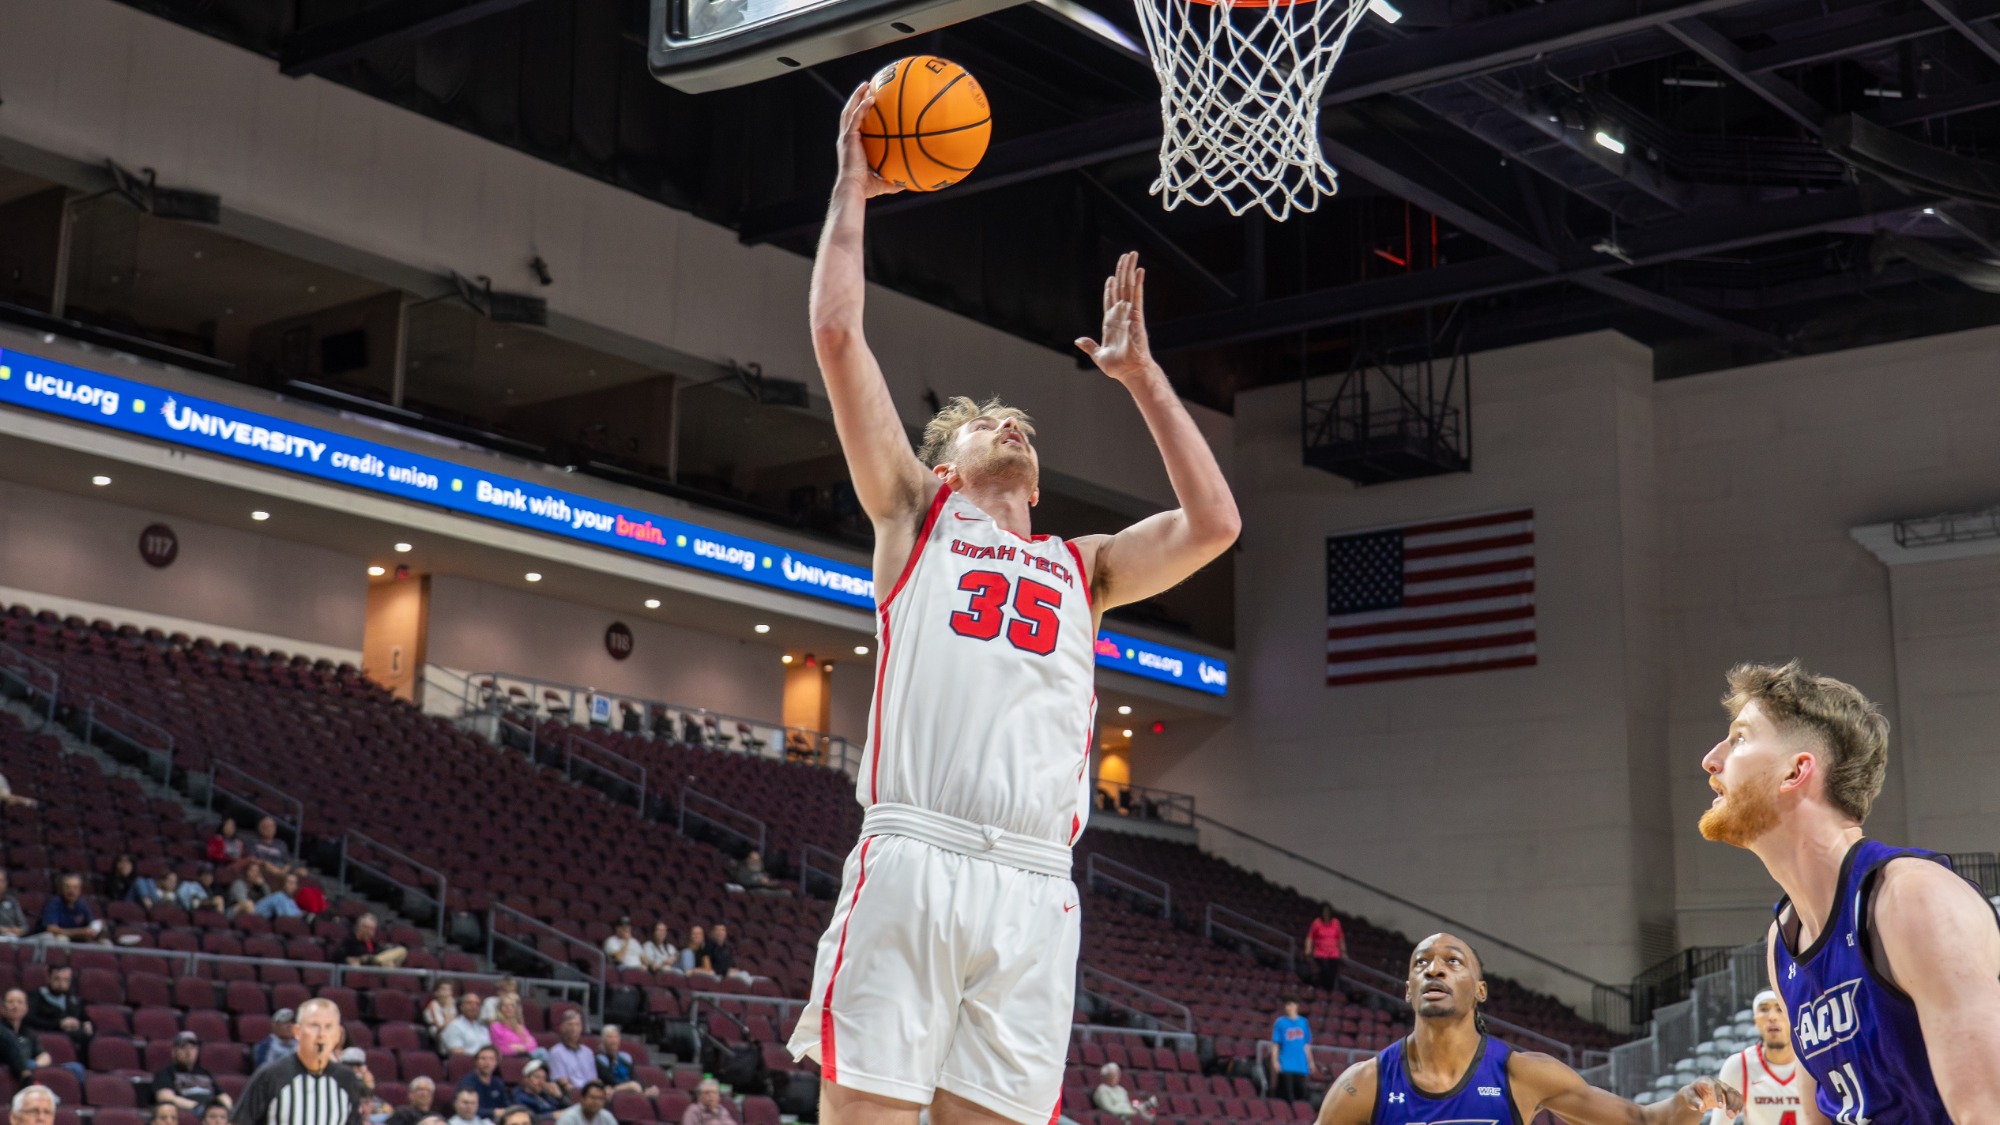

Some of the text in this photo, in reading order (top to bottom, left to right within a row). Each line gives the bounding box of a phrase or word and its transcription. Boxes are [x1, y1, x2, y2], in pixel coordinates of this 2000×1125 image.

[25, 371, 119, 415] ucu.org
[164, 398, 439, 492] UNIVERSITY credit union
[476, 479, 667, 546] Bank with your brain.
[147, 534, 174, 557] 117
[693, 538, 755, 572] ucu.org
[950, 539, 1074, 589] UTAH TECH
[782, 555, 874, 599] UNIVERSIT
[949, 570, 1062, 656] 35
[1800, 991, 1854, 1050] ACU
[1477, 1086, 1501, 1096] WAC
[1754, 1096, 1801, 1105] UTAH TE
[1828, 1062, 1872, 1125] 21
